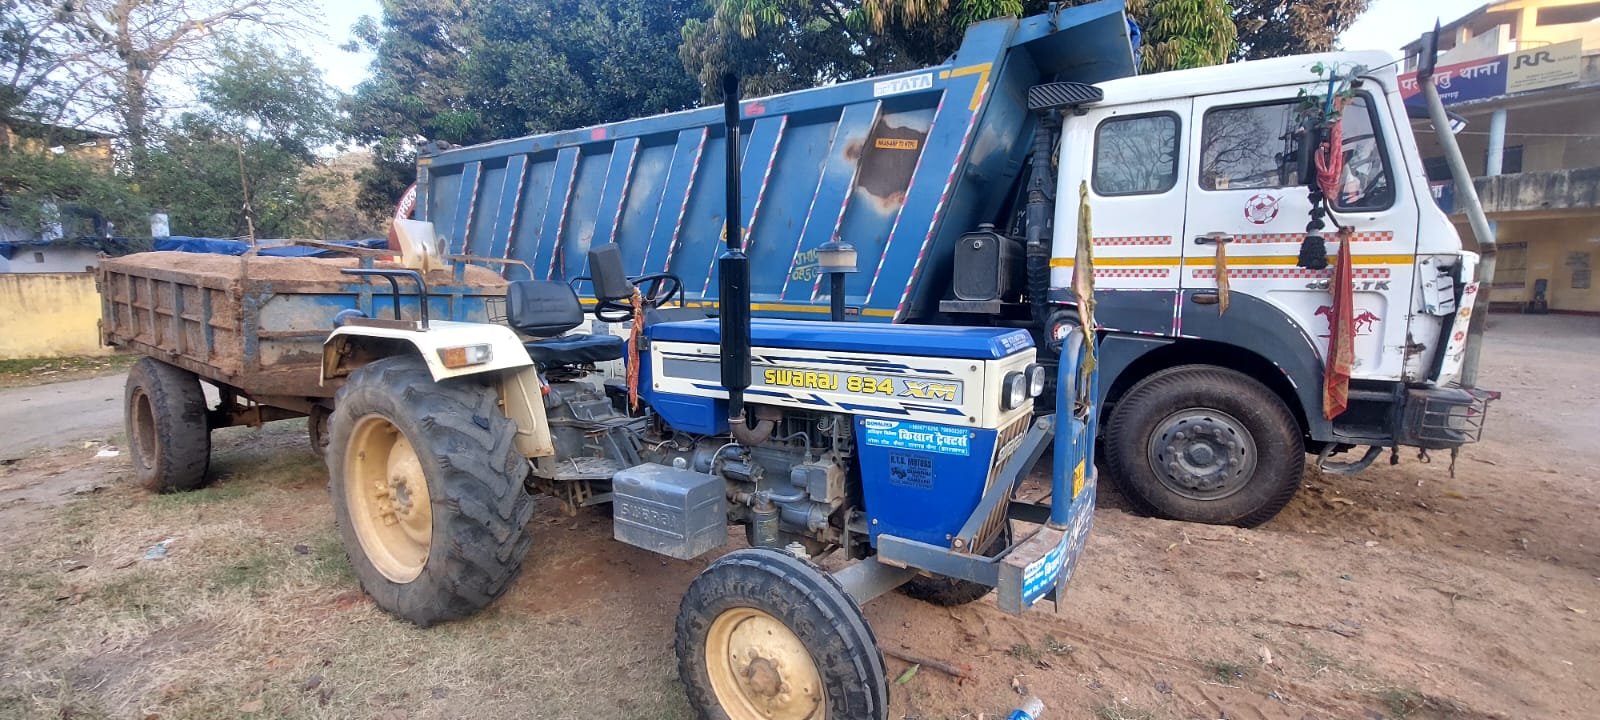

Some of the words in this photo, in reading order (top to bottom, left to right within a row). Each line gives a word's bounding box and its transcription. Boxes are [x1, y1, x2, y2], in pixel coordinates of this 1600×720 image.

[889, 75, 932, 92] TATA
[1401, 70, 1452, 89] पतातु
[1459, 61, 1500, 80] थाना
[764, 369, 839, 390] SWARAJ
[846, 376, 895, 395] 834
[896, 379, 959, 401] XM
[898, 428, 934, 443] किसान
